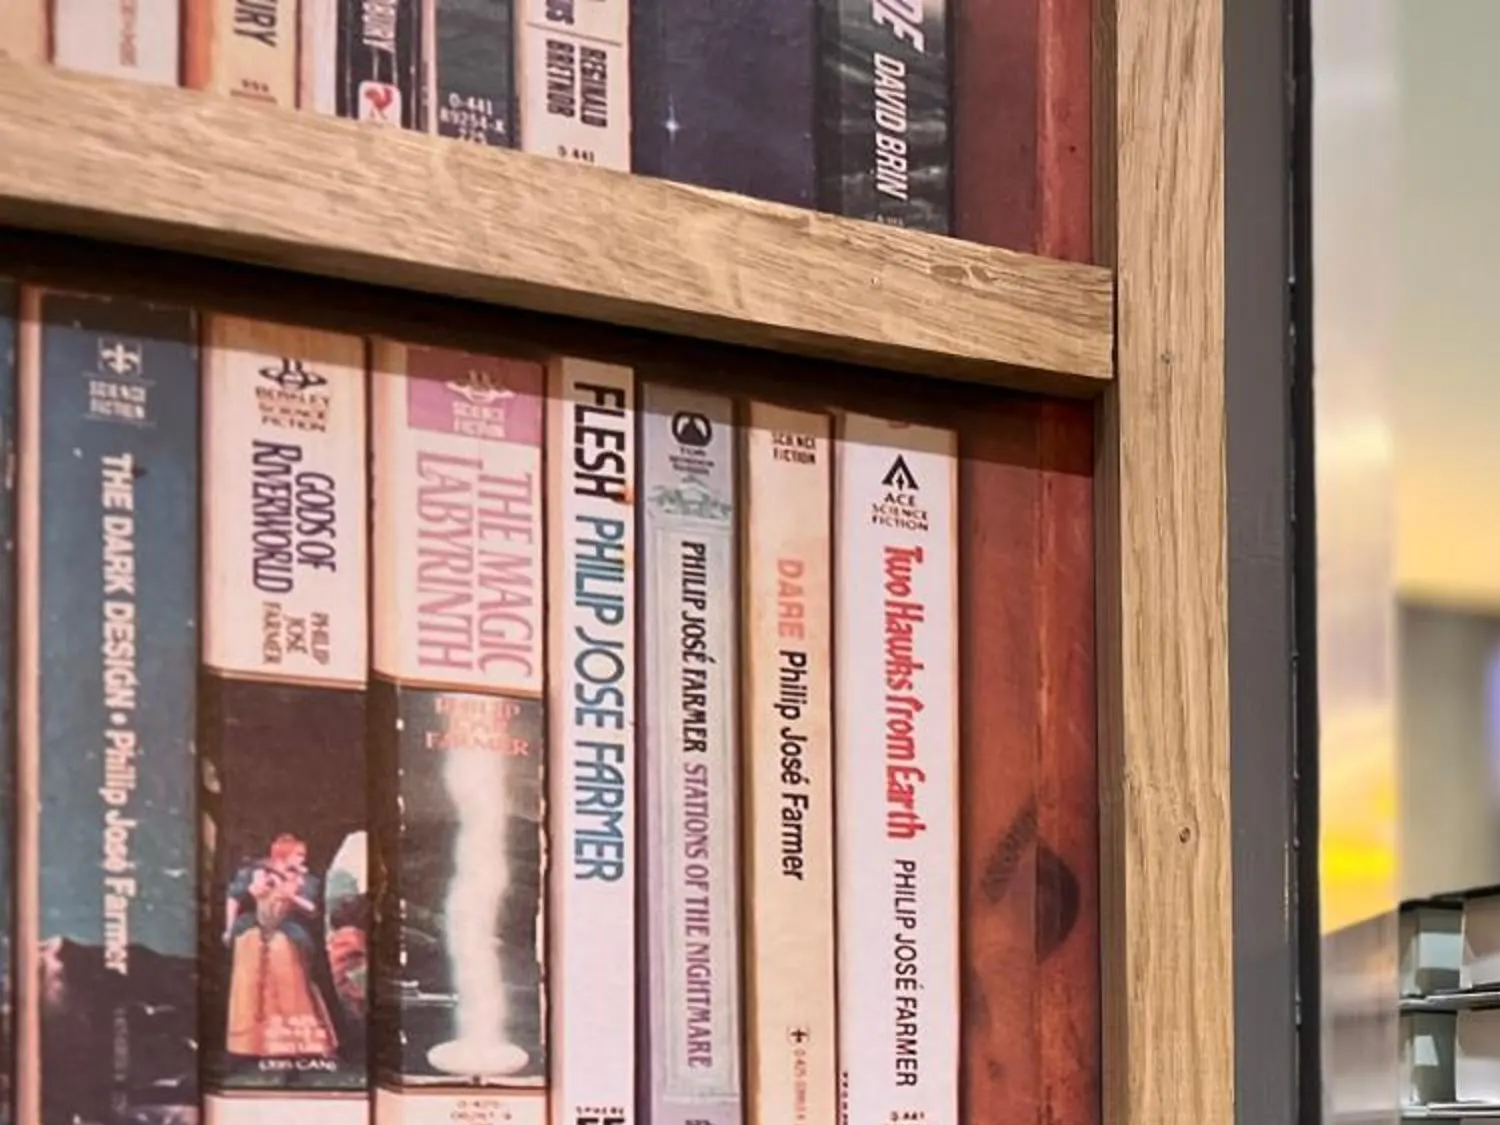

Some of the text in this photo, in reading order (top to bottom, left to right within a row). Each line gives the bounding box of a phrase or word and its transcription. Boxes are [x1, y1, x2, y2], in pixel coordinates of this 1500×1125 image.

[546, 38, 576, 118] BRETNOR
[580, 44, 608, 128] REGINALD
[873, 52, 909, 132] DAVID
[875, 131, 909, 201] BRIN
[101, 452, 134, 508] THE
[573, 381, 625, 501] FLESH
[296, 471, 337, 573] GODS OF
[477, 472, 532, 544] THE
[872, 503, 928, 521] SCIENCE
[872, 515, 929, 532] FICTION
[884, 492, 915, 507] ACE
[102, 515, 135, 595] DARK
[415, 450, 483, 671] LABYRINTH
[574, 515, 625, 626] PHILIP
[102, 600, 137, 709] DESIGN
[476, 548, 533, 678] MAGIC
[773, 559, 809, 881] DARE Philip José Farmer
[884, 545, 927, 840] Two Hawks from Earth
[99, 730, 137, 805] Philip
[573, 740, 626, 883] FARMER
[681, 540, 717, 1069] PHILIP JOSÉ FARMER STATIONS OF THE NIGHTMARE
[104, 876, 138, 976] Farmer
[894, 859, 924, 1087] PHILIP JOSÉ FARMER
